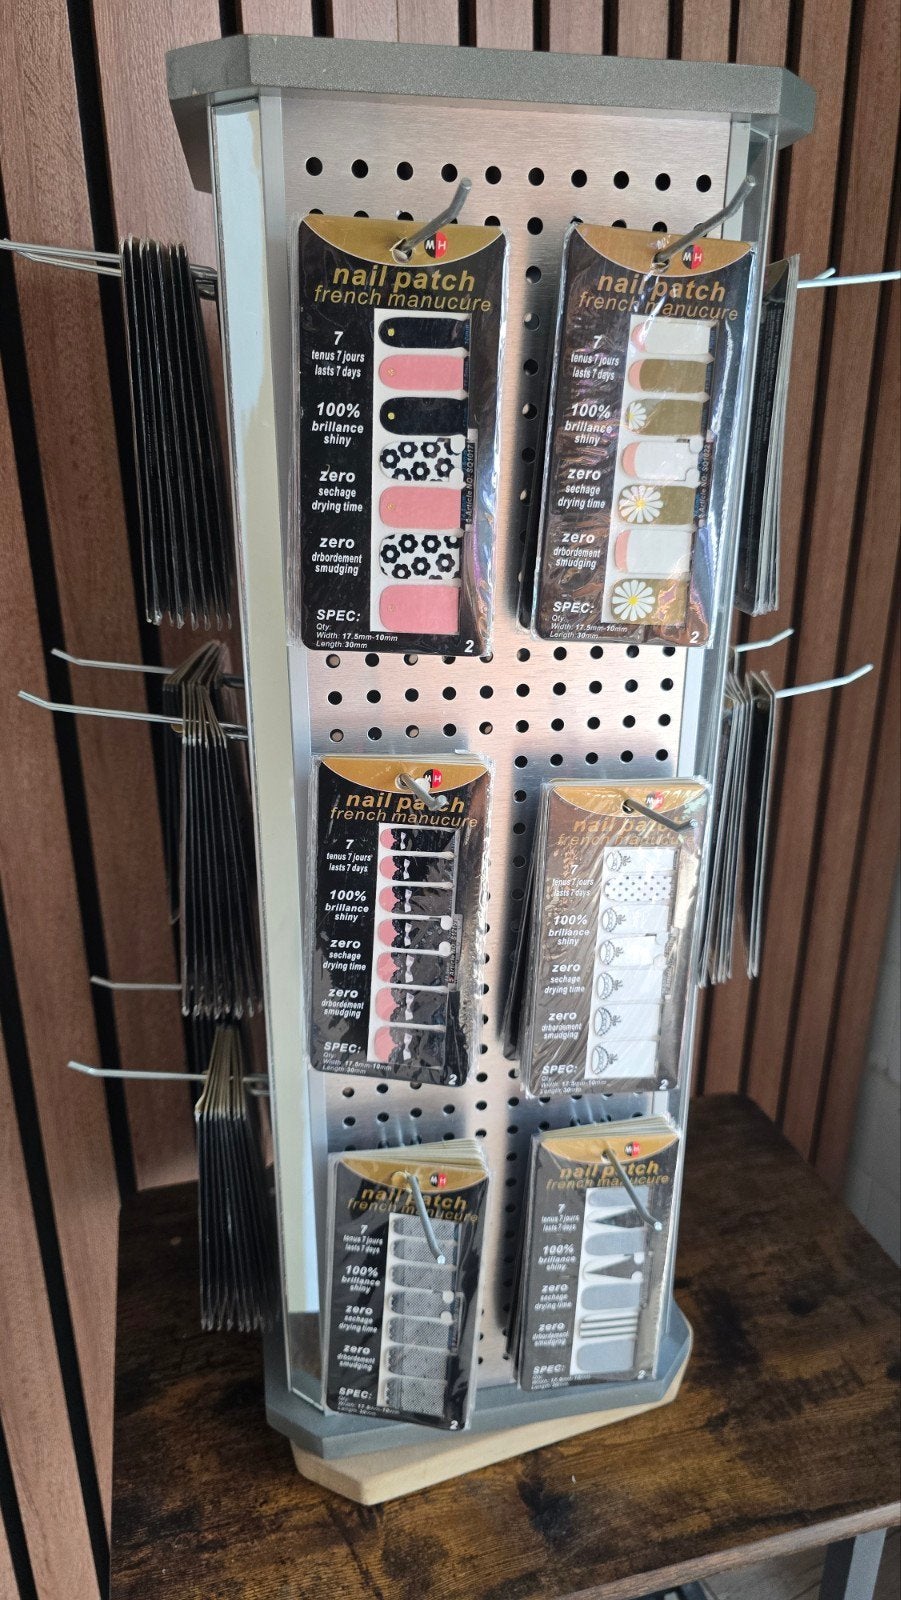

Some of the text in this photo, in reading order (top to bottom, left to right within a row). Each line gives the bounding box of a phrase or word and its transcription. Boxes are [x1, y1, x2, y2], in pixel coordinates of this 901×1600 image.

[425, 240, 446, 250] MH
[683, 252, 702, 262] MH
[333, 265, 475, 292] nail patch
[597, 274, 725, 302] nail patch
[314, 285, 491, 311] french manucure
[579, 292, 738, 321] french manucure
[334, 331, 343, 345] 7
[594, 336, 602, 349] 7
[312, 350, 365, 363] tenus 7 jours
[571, 353, 619, 366] tenus 7 jours
[315, 365, 361, 378] lasts 7 days
[573, 367, 615, 380] lasts 7 days
[317, 402, 360, 419] 100%
[571, 402, 610, 418] 100%
[312, 421, 364, 434] brillance
[564, 420, 612, 433] brillance
[324, 434, 351, 447] shiny
[574, 434, 600, 446] shiny
[319, 470, 355, 483] zero
[568, 469, 601, 480] zero
[319, 487, 356, 498] sechage
[566, 485, 600, 495] sechage
[312, 501, 363, 513] drying time
[558, 499, 605, 509] drying time
[320, 537, 354, 549] zero
[562, 532, 595, 543] zero
[312, 553, 362, 563] drbordement
[554, 547, 600, 558] drbordement
[556, 558, 596, 569] smudging
[315, 563, 359, 576] smudging
[553, 602, 594, 613] SPEC:
[317, 610, 360, 621] SPEC:
[690, 631, 700, 643] 2
[465, 640, 474, 653] 2
[347, 792, 391, 808] nail
[330, 807, 478, 828] french manucure
[346, 840, 354, 849] 7
[327, 853, 347, 861] tenus
[329, 863, 345, 871] lasts
[352, 865, 368, 874] days
[571, 865, 578, 874] 7
[330, 890, 366, 901] 100%
[325, 903, 369, 913] brillance
[335, 913, 358, 922] shiny
[554, 915, 587, 925] 100%
[330, 940, 361, 948] zero
[557, 938, 580, 946] shiny
[329, 951, 361, 960] sechage
[323, 962, 347, 971] drying
[552, 963, 580, 972] zero
[329, 989, 358, 998] zero
[544, 986, 567, 994] drying
[324, 1009, 361, 1019] smudging
[549, 1012, 576, 1020] zero
[324, 1042, 361, 1053] SPEC:
[542, 1065, 578, 1074] SPEC:
[448, 1074, 457, 1085] 2
[659, 1080, 668, 1090] 2
[560, 1160, 659, 1179] nail ptch
[431, 1176, 446, 1184] MH
[362, 1188, 402, 1200] nail
[348, 1198, 397, 1212] french
[361, 1225, 368, 1234] 7
[543, 1244, 574, 1254] 100%
[346, 1265, 378, 1277] 100%
[542, 1284, 568, 1293] zero
[346, 1305, 373, 1315] zero
[539, 1323, 565, 1332] zero
[343, 1344, 370, 1355] zero
[450, 1420, 458, 1429] 2
